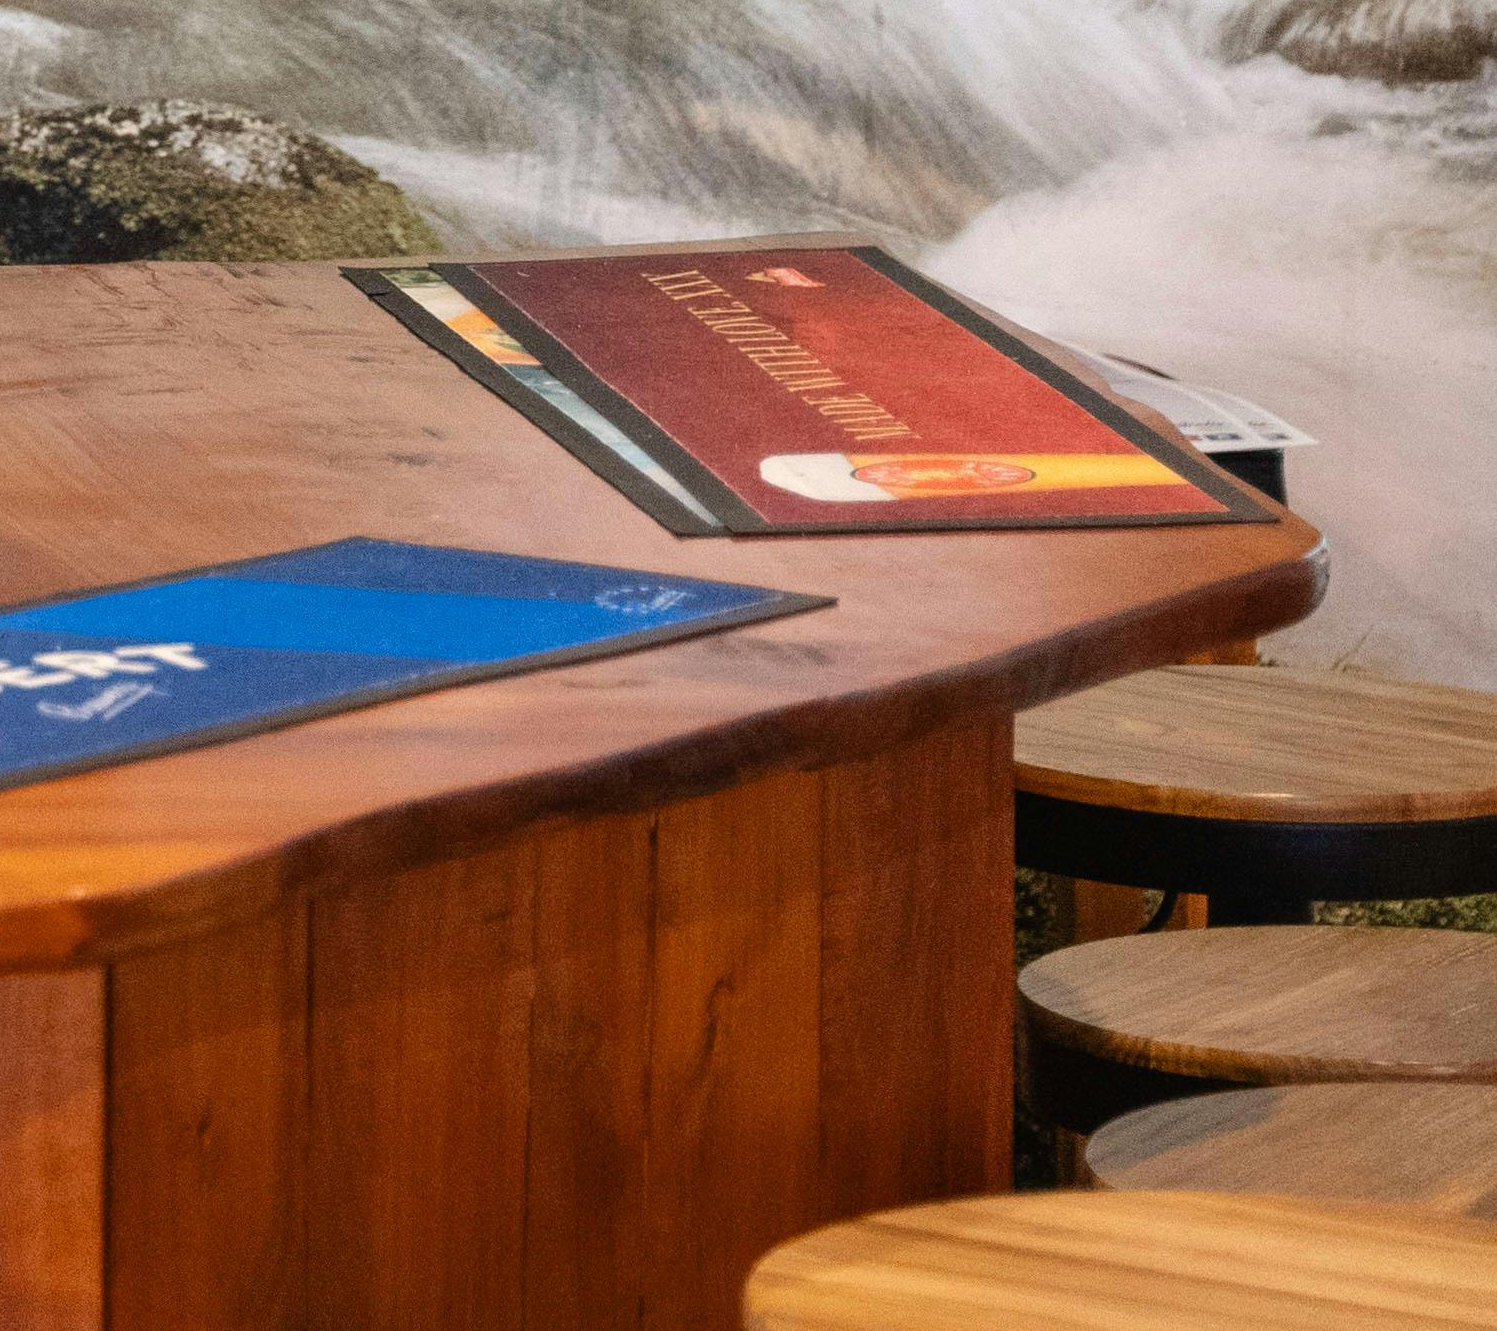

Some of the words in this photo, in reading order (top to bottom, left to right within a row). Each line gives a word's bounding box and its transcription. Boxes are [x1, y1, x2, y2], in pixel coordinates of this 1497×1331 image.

[687, 300, 791, 344] LOVE
[738, 343, 850, 393] WITH
[801, 392, 923, 441] MADE
